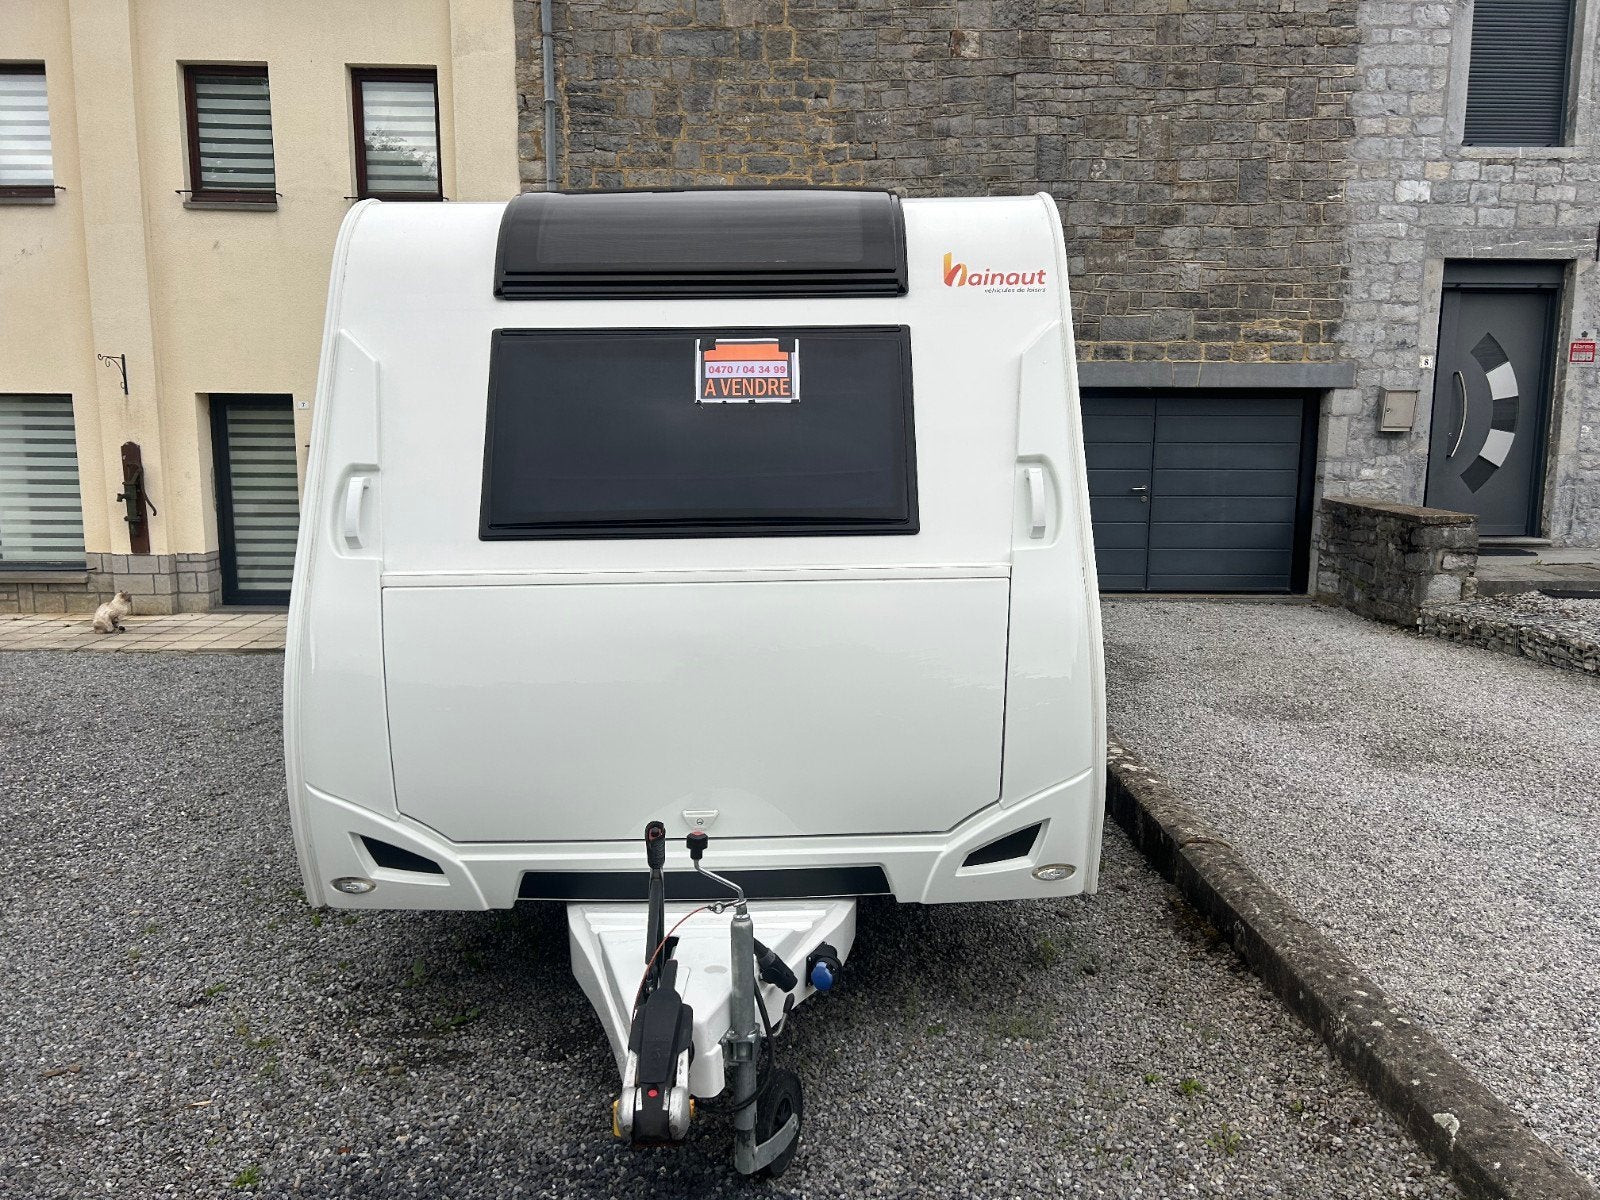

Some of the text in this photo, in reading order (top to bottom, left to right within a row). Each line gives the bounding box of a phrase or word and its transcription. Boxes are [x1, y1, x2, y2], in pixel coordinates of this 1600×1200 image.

[943, 252, 1047, 287] hainaut
[708, 365, 787, 374] 0470 / 04 34 99
[704, 378, 791, 397] A VENDRE
